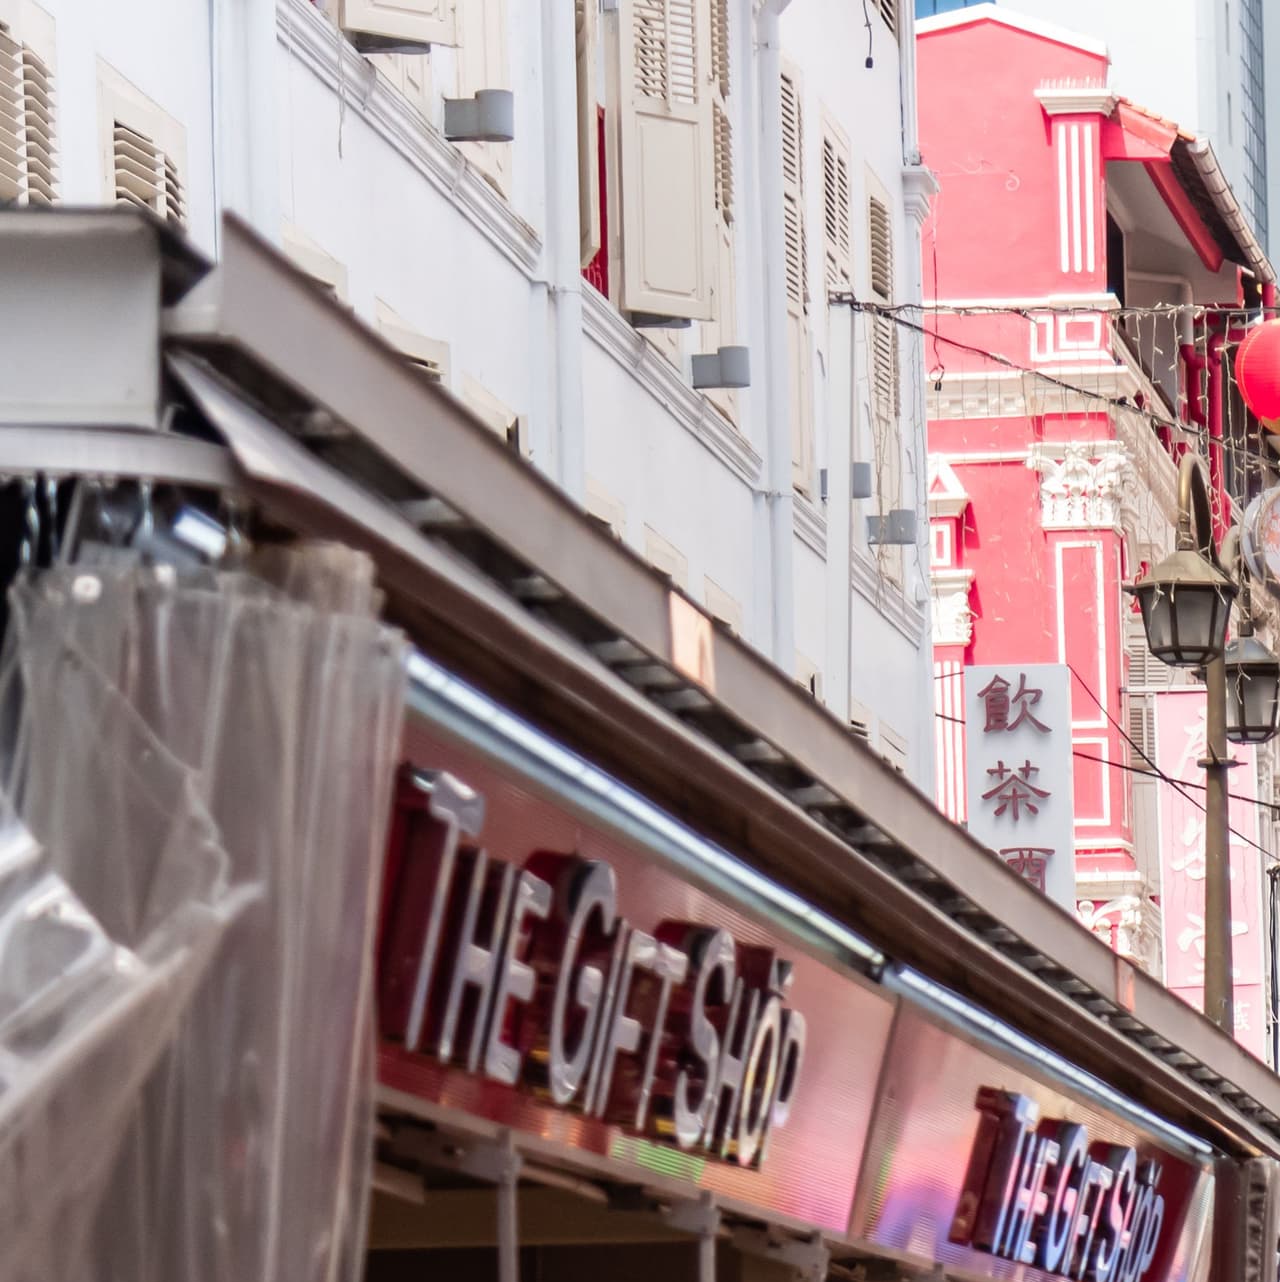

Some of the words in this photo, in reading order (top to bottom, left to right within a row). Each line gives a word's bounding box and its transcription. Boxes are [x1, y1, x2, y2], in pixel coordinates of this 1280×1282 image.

[404, 770, 553, 1085] THE
[549, 859, 689, 1132] GIFT
[674, 926, 806, 1167] SHOP
[992, 1094, 1060, 1264] THE
[1045, 1124, 1114, 1282] GIFT
